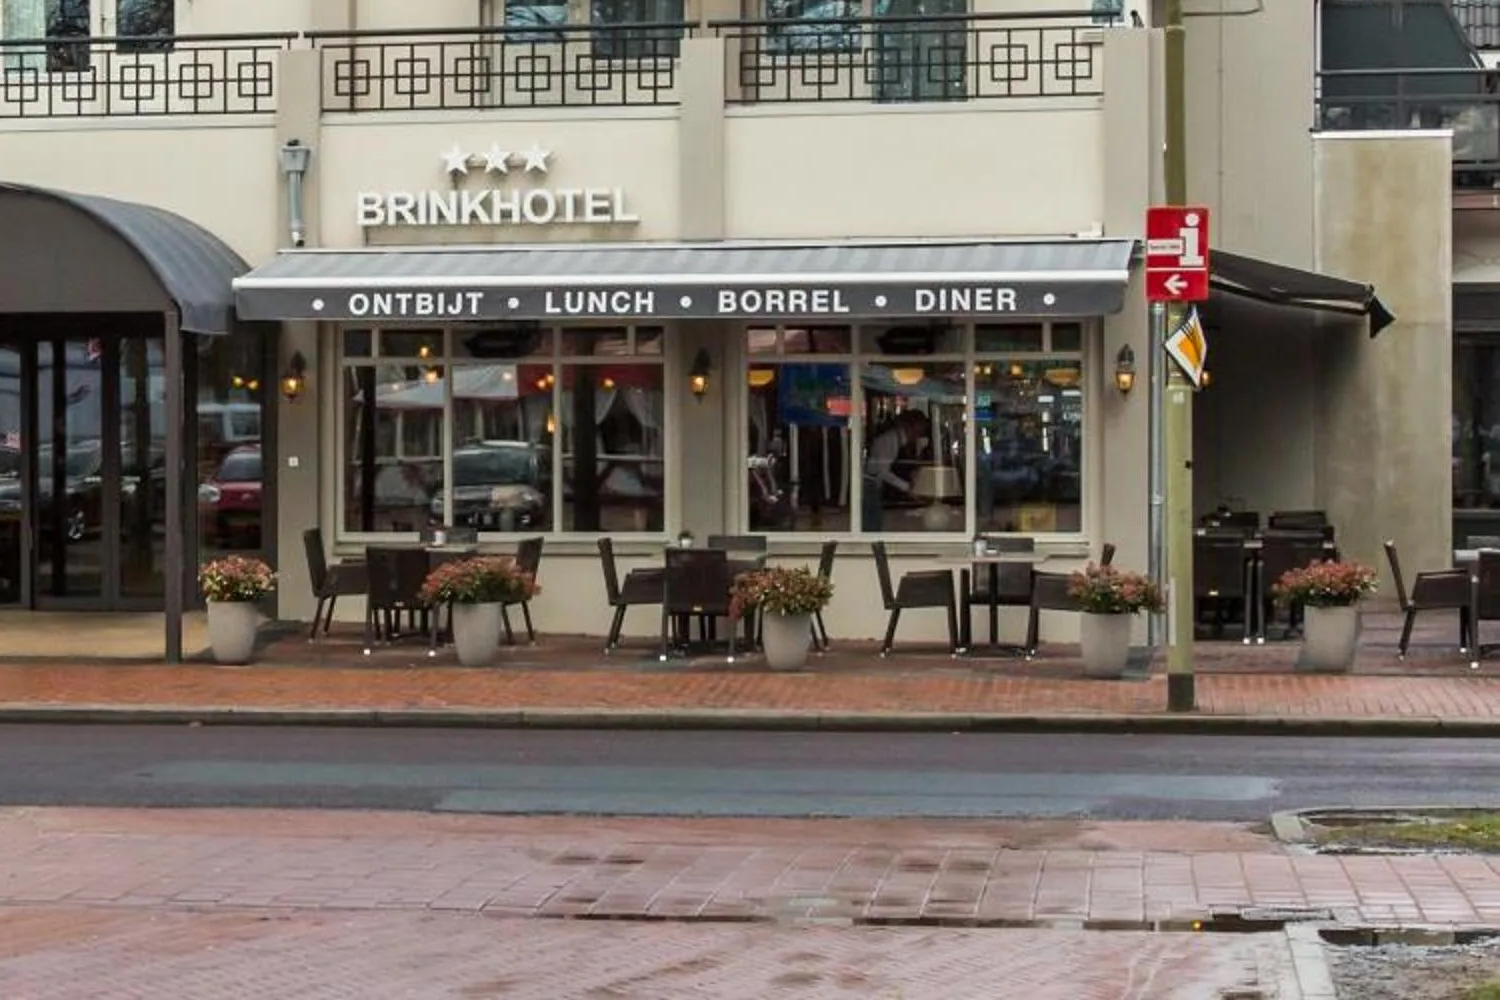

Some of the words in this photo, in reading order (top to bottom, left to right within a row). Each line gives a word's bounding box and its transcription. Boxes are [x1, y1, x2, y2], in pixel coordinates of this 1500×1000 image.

[357, 188, 639, 226] BRINKHOTEL
[348, 291, 485, 316] ONTBIJT
[545, 290, 654, 314] LUNCH
[718, 288, 850, 314] BORREL
[915, 287, 1017, 313] DINER
